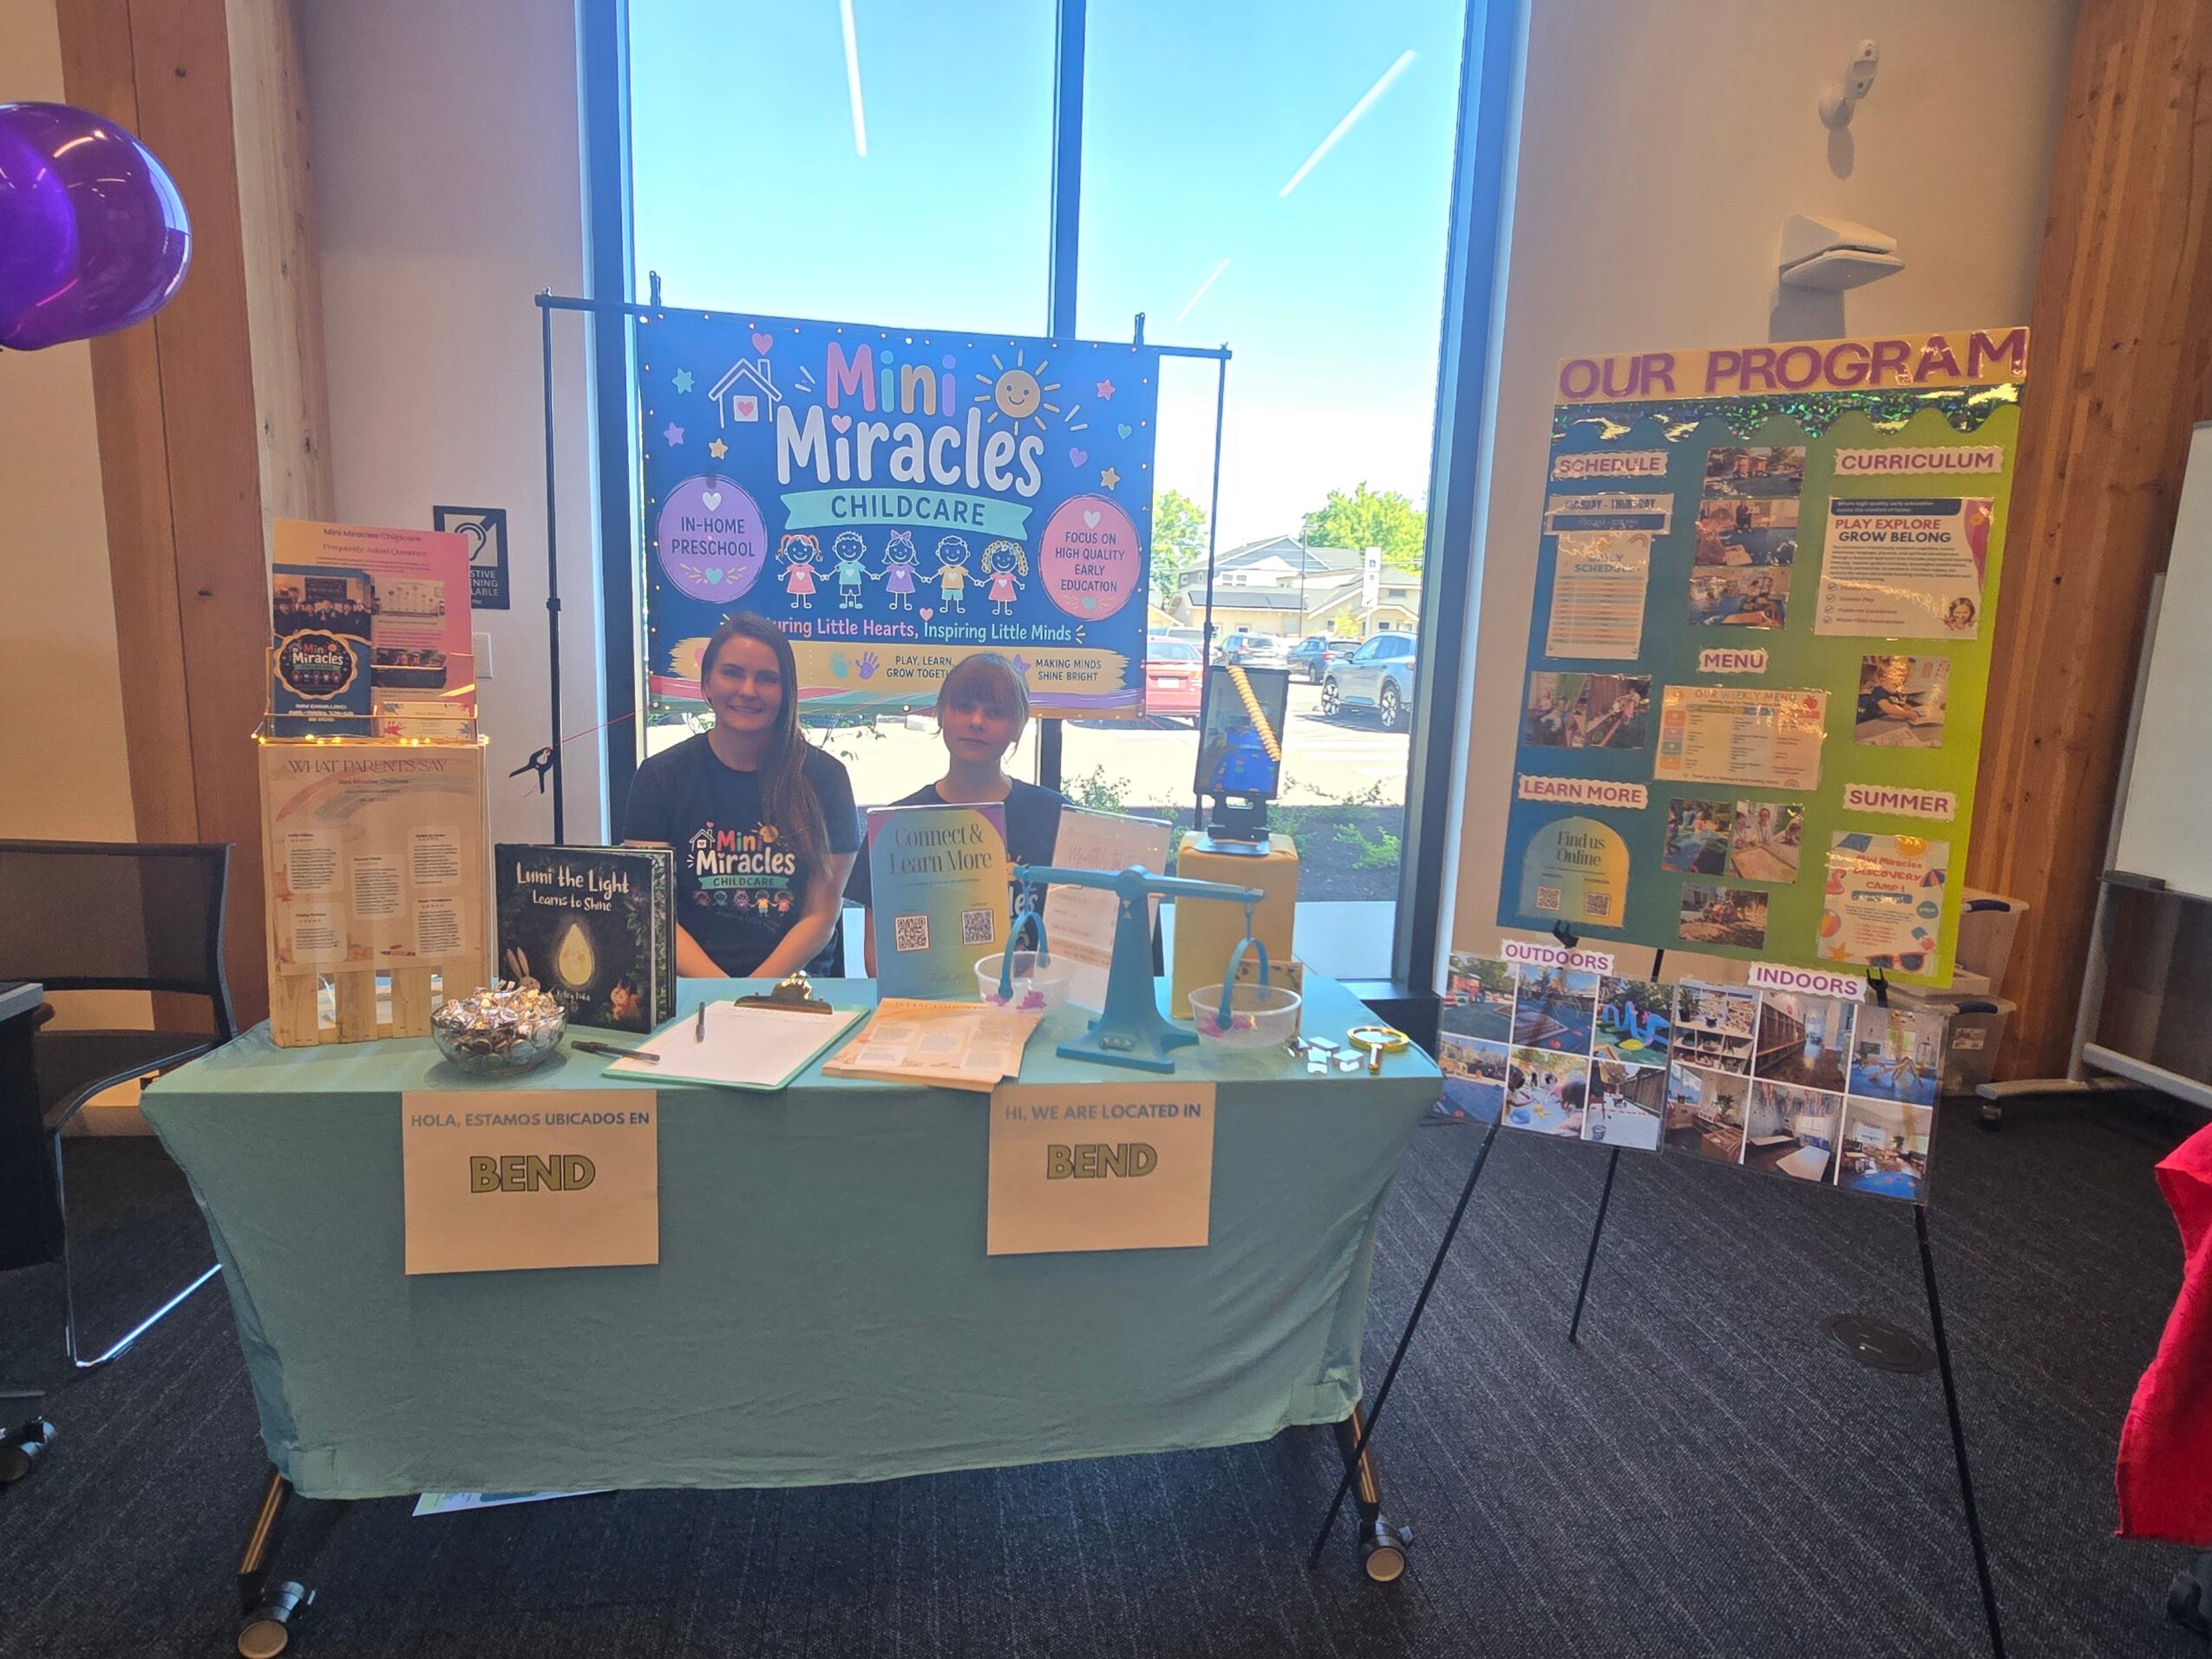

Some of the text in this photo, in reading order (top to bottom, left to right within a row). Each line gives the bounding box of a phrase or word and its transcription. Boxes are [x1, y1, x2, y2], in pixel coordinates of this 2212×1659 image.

[1560, 328, 2029, 400] OUR PROGRAM
[827, 341, 956, 417] Mini
[777, 404, 1044, 498] Miracles
[1560, 457, 1661, 474] SCHEDULE
[1841, 452, 1994, 472] CURRICULUM
[830, 494, 986, 527] CHILDCARE
[681, 517, 744, 534] IN-HOME
[1835, 519, 1941, 530] PLAY EXPLORE
[1064, 531, 1117, 545] FOCUS ON
[1838, 532, 1952, 543] GROW BELONG
[671, 539, 756, 558] PRESCHOOL
[1055, 547, 1125, 563] HIGH QUALITY
[470, 569, 496, 578] STIVE
[1074, 564, 1106, 577] EARLY
[471, 587, 500, 598] LABLE
[1060, 578, 1118, 593] EDUCATION
[817, 618, 859, 636] Little
[863, 620, 919, 639] Hearts,
[924, 622, 987, 643] Inspiring
[991, 622, 1028, 641] Little
[1031, 624, 1072, 642] Minds
[292, 651, 344, 665] Miracles
[895, 656, 954, 667] PLAY, LEARN,
[1036, 658, 1102, 669] MAKING MINDS
[1703, 652, 1764, 669] MENU
[887, 668, 949, 679] GROW TOGET
[1037, 671, 1098, 682] SHINE BRIGHT
[1764, 693, 1796, 702] MENU
[288, 758, 448, 773] WHAT PARENTS SAY
[1522, 781, 1642, 804] LEARN MORE
[1849, 789, 1950, 813] SUMMER
[717, 830, 763, 852] Mini
[895, 822, 984, 847] Connect &
[1558, 831, 1606, 849] Find us
[697, 846, 795, 876] Miracles
[889, 850, 992, 875] Learn More
[1557, 848, 1601, 866] Online
[1880, 857, 1923, 869] Miracles
[516, 861, 630, 900] Lumi the Light
[713, 876, 776, 887] CHILDCARE
[1853, 869, 1922, 882] DISCOVERY
[533, 889, 612, 911] Learns to Shine
[1505, 942, 1609, 971] OUTDOORS
[1755, 965, 1859, 996] INDOORS
[410, 1112, 650, 1128] HOLA, ESTAMOS UBICADOS EN
[1005, 1103, 1201, 1122] HI, WE ARE LOCATED IN
[1046, 1142, 1159, 1180] BEND
[469, 1154, 596, 1193] BEND
